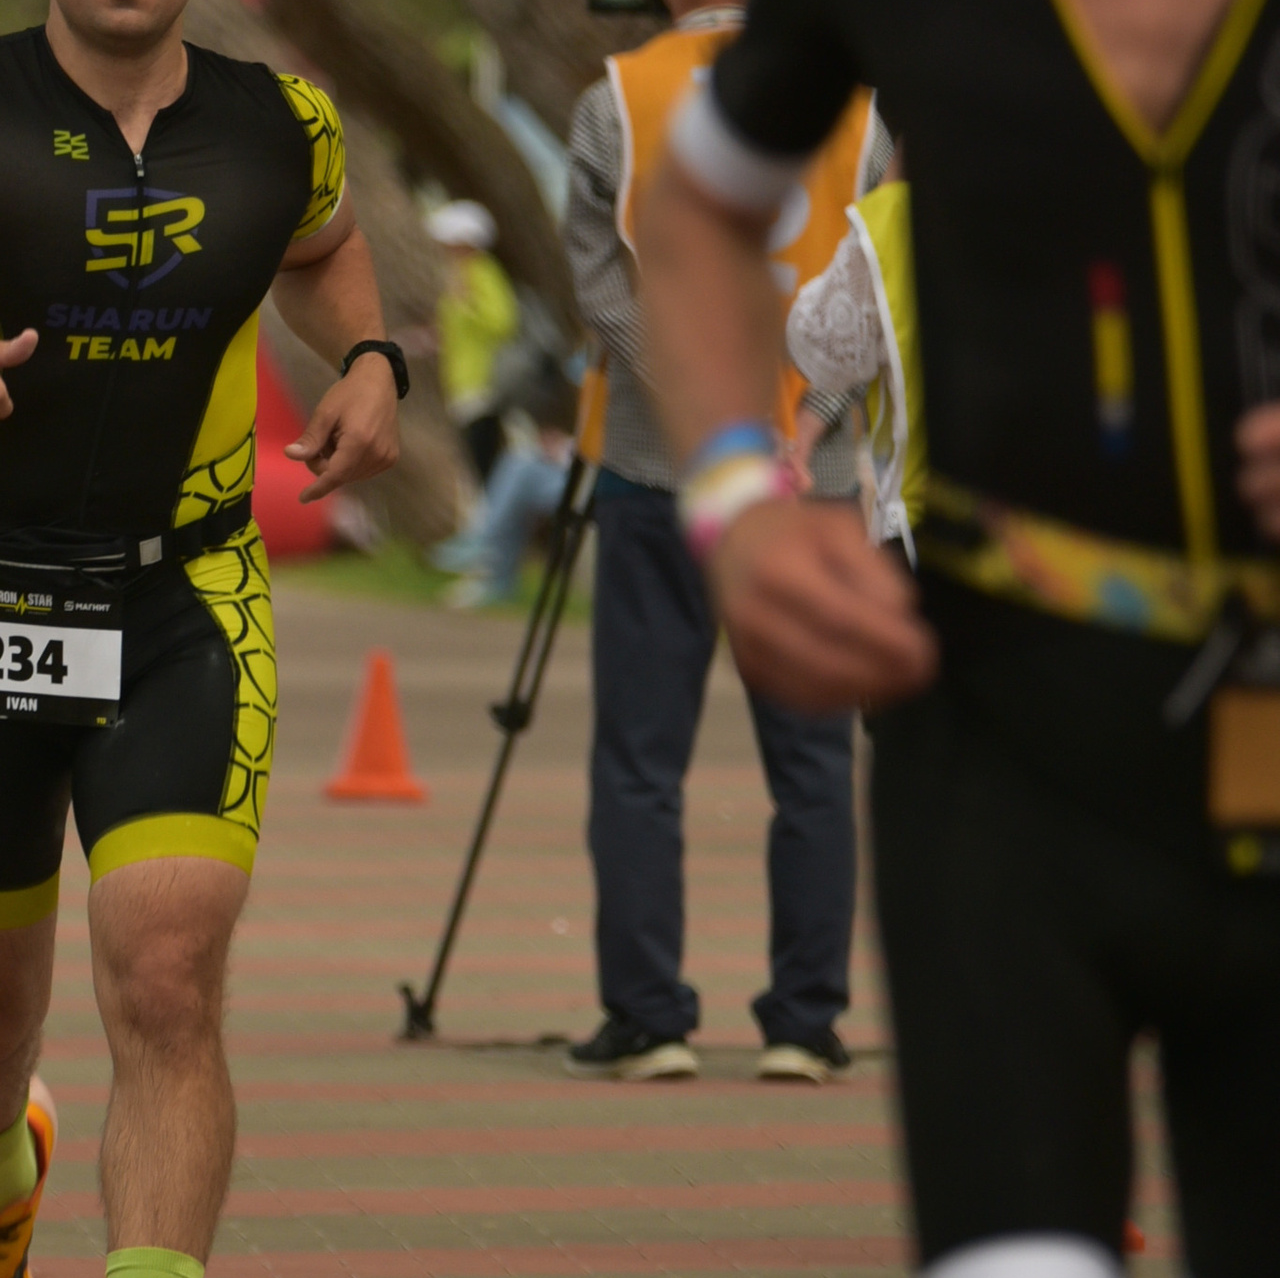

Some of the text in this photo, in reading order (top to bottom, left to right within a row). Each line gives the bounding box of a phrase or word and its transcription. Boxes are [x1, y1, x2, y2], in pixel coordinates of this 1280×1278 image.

[67, 335, 177, 361] TEAM
[27, 593, 53, 607] STAR
[75, 603, 111, 612] МАГНИТ
[6, 696, 38, 711] IVAN
